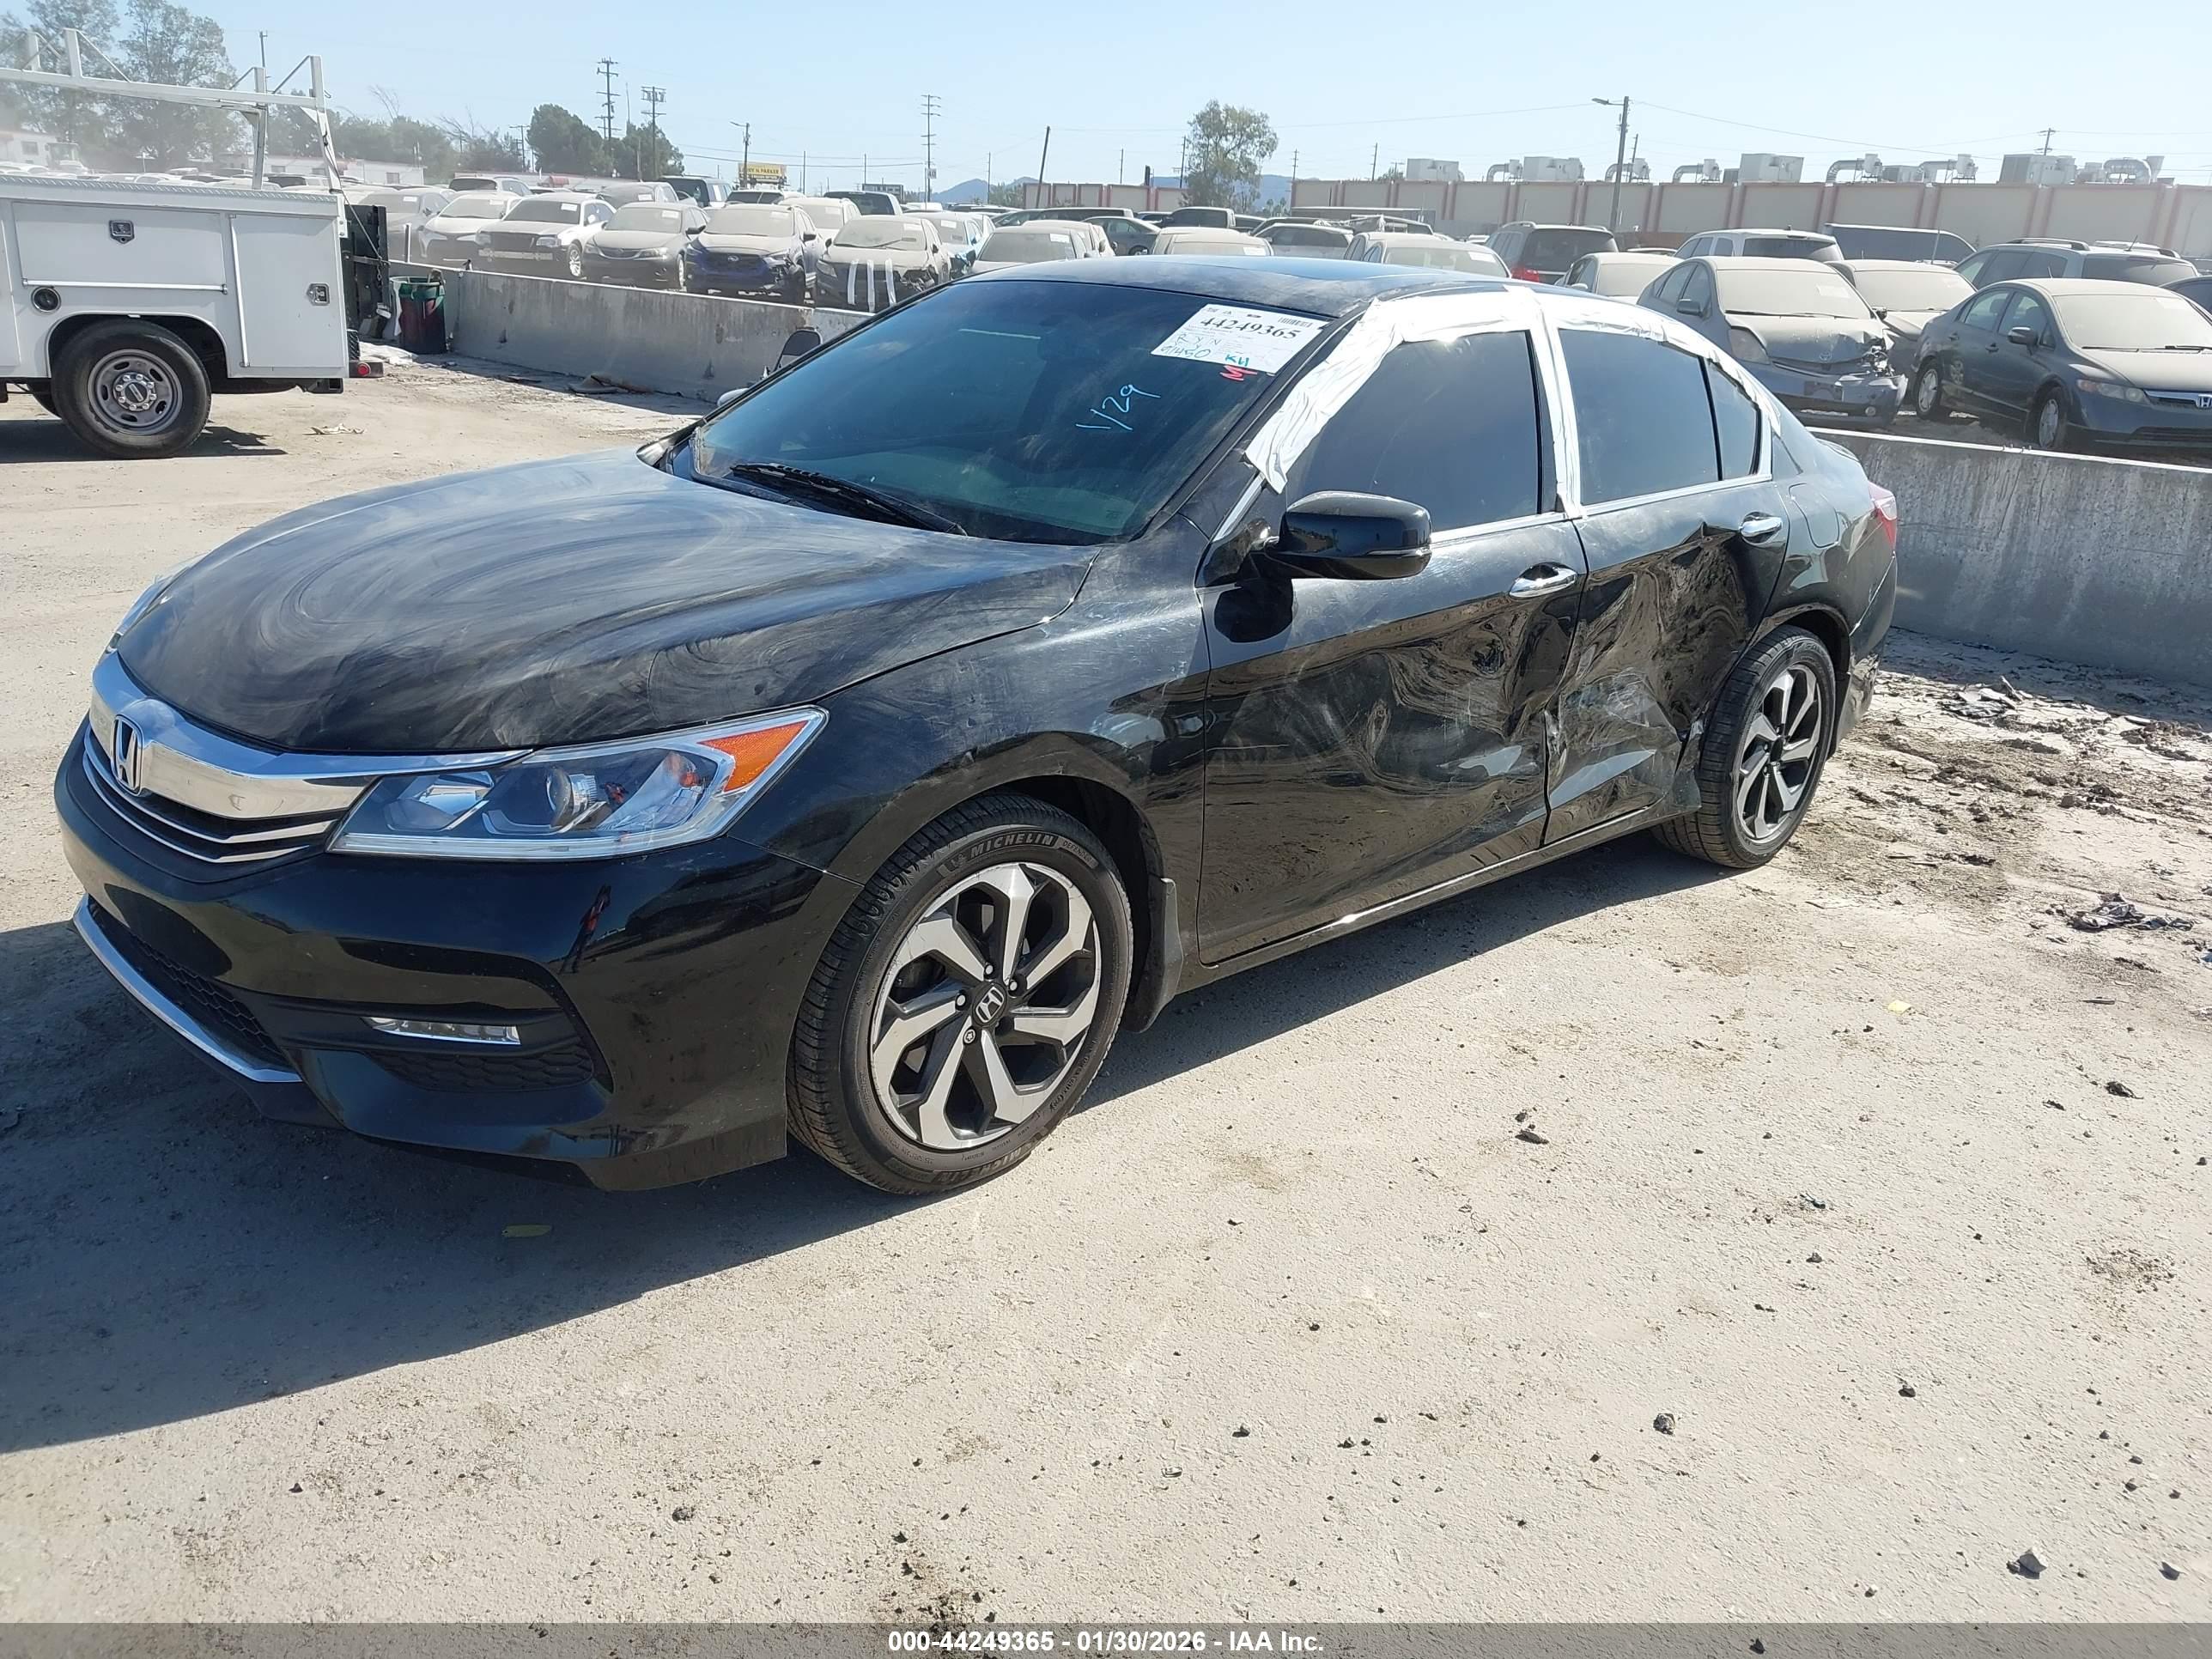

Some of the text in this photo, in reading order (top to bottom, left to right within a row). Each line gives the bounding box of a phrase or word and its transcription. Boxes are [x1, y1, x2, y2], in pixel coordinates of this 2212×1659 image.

[1200, 317, 1301, 339] 44249365
[1075, 384, 1161, 430] 1/29
[970, 833, 1054, 859] MICHELIN
